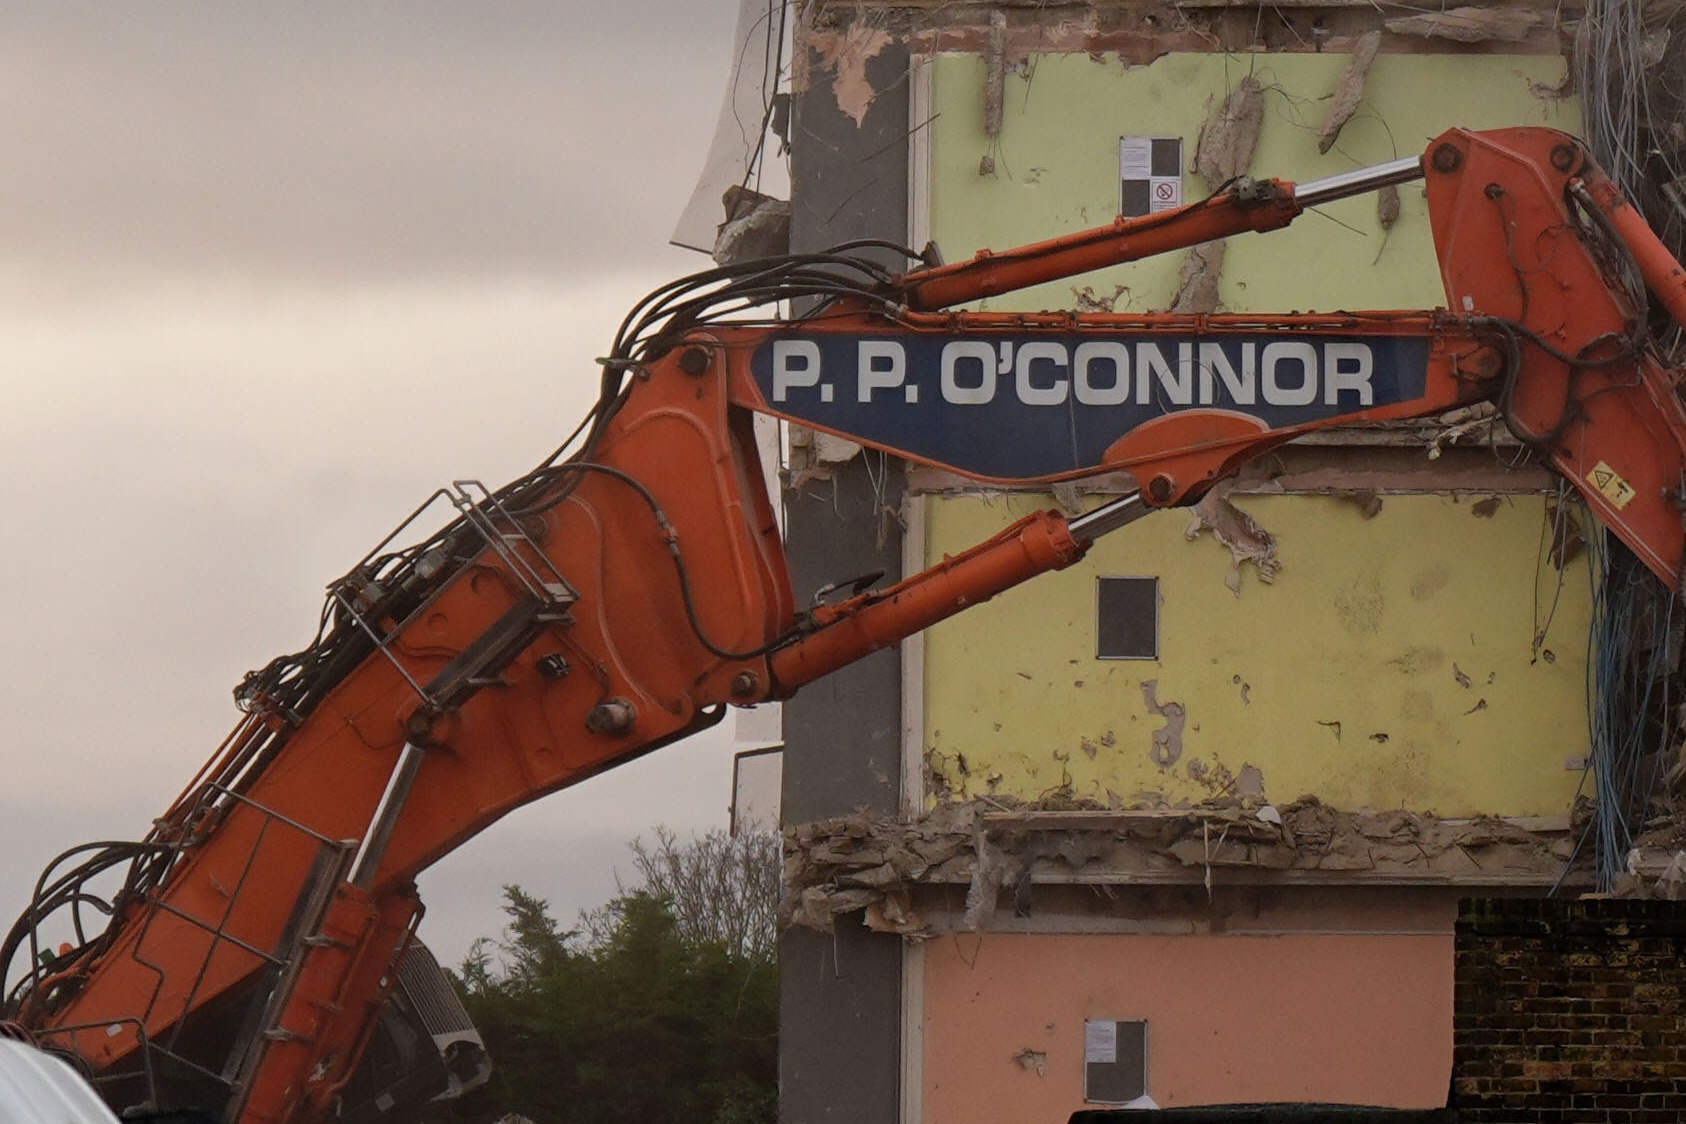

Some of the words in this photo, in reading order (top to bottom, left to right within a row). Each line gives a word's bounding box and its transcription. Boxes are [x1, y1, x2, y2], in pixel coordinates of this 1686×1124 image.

[772, 340, 834, 402] P.
[857, 340, 918, 403] P.
[940, 341, 1373, 406] O'CONNOR
